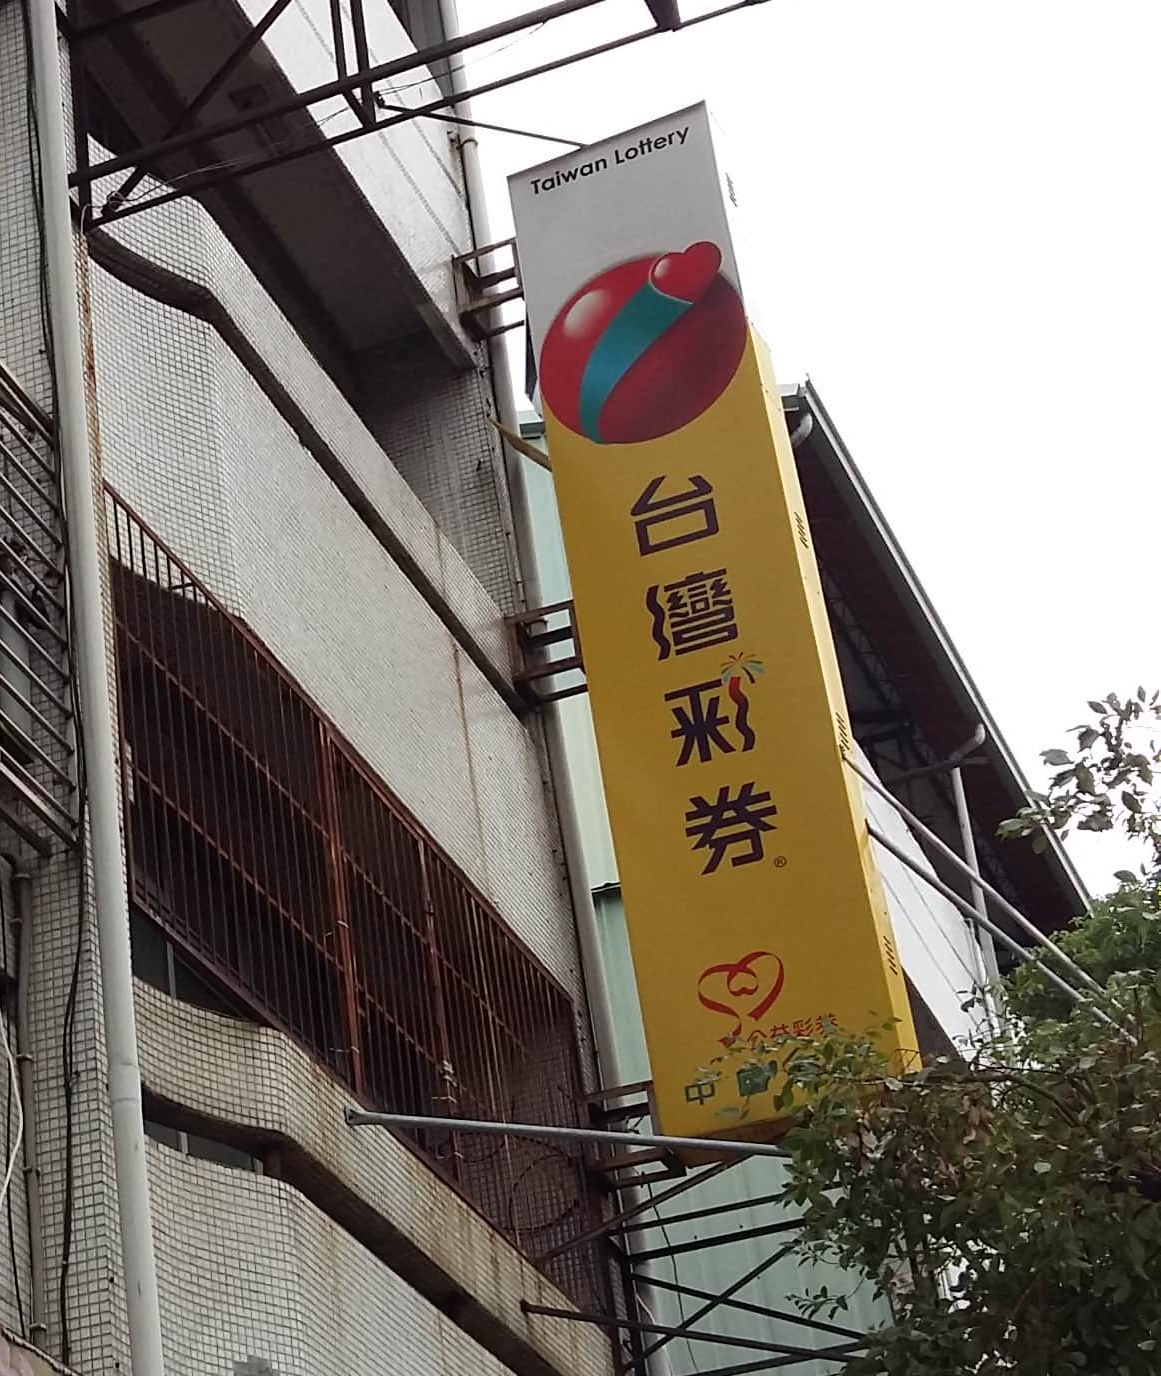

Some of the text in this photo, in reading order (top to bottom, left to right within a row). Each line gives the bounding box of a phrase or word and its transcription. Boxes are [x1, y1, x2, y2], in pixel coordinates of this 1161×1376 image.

[530, 127, 690, 194] Taiwan Lottery
[630, 475, 778, 875] 台灣彩券
